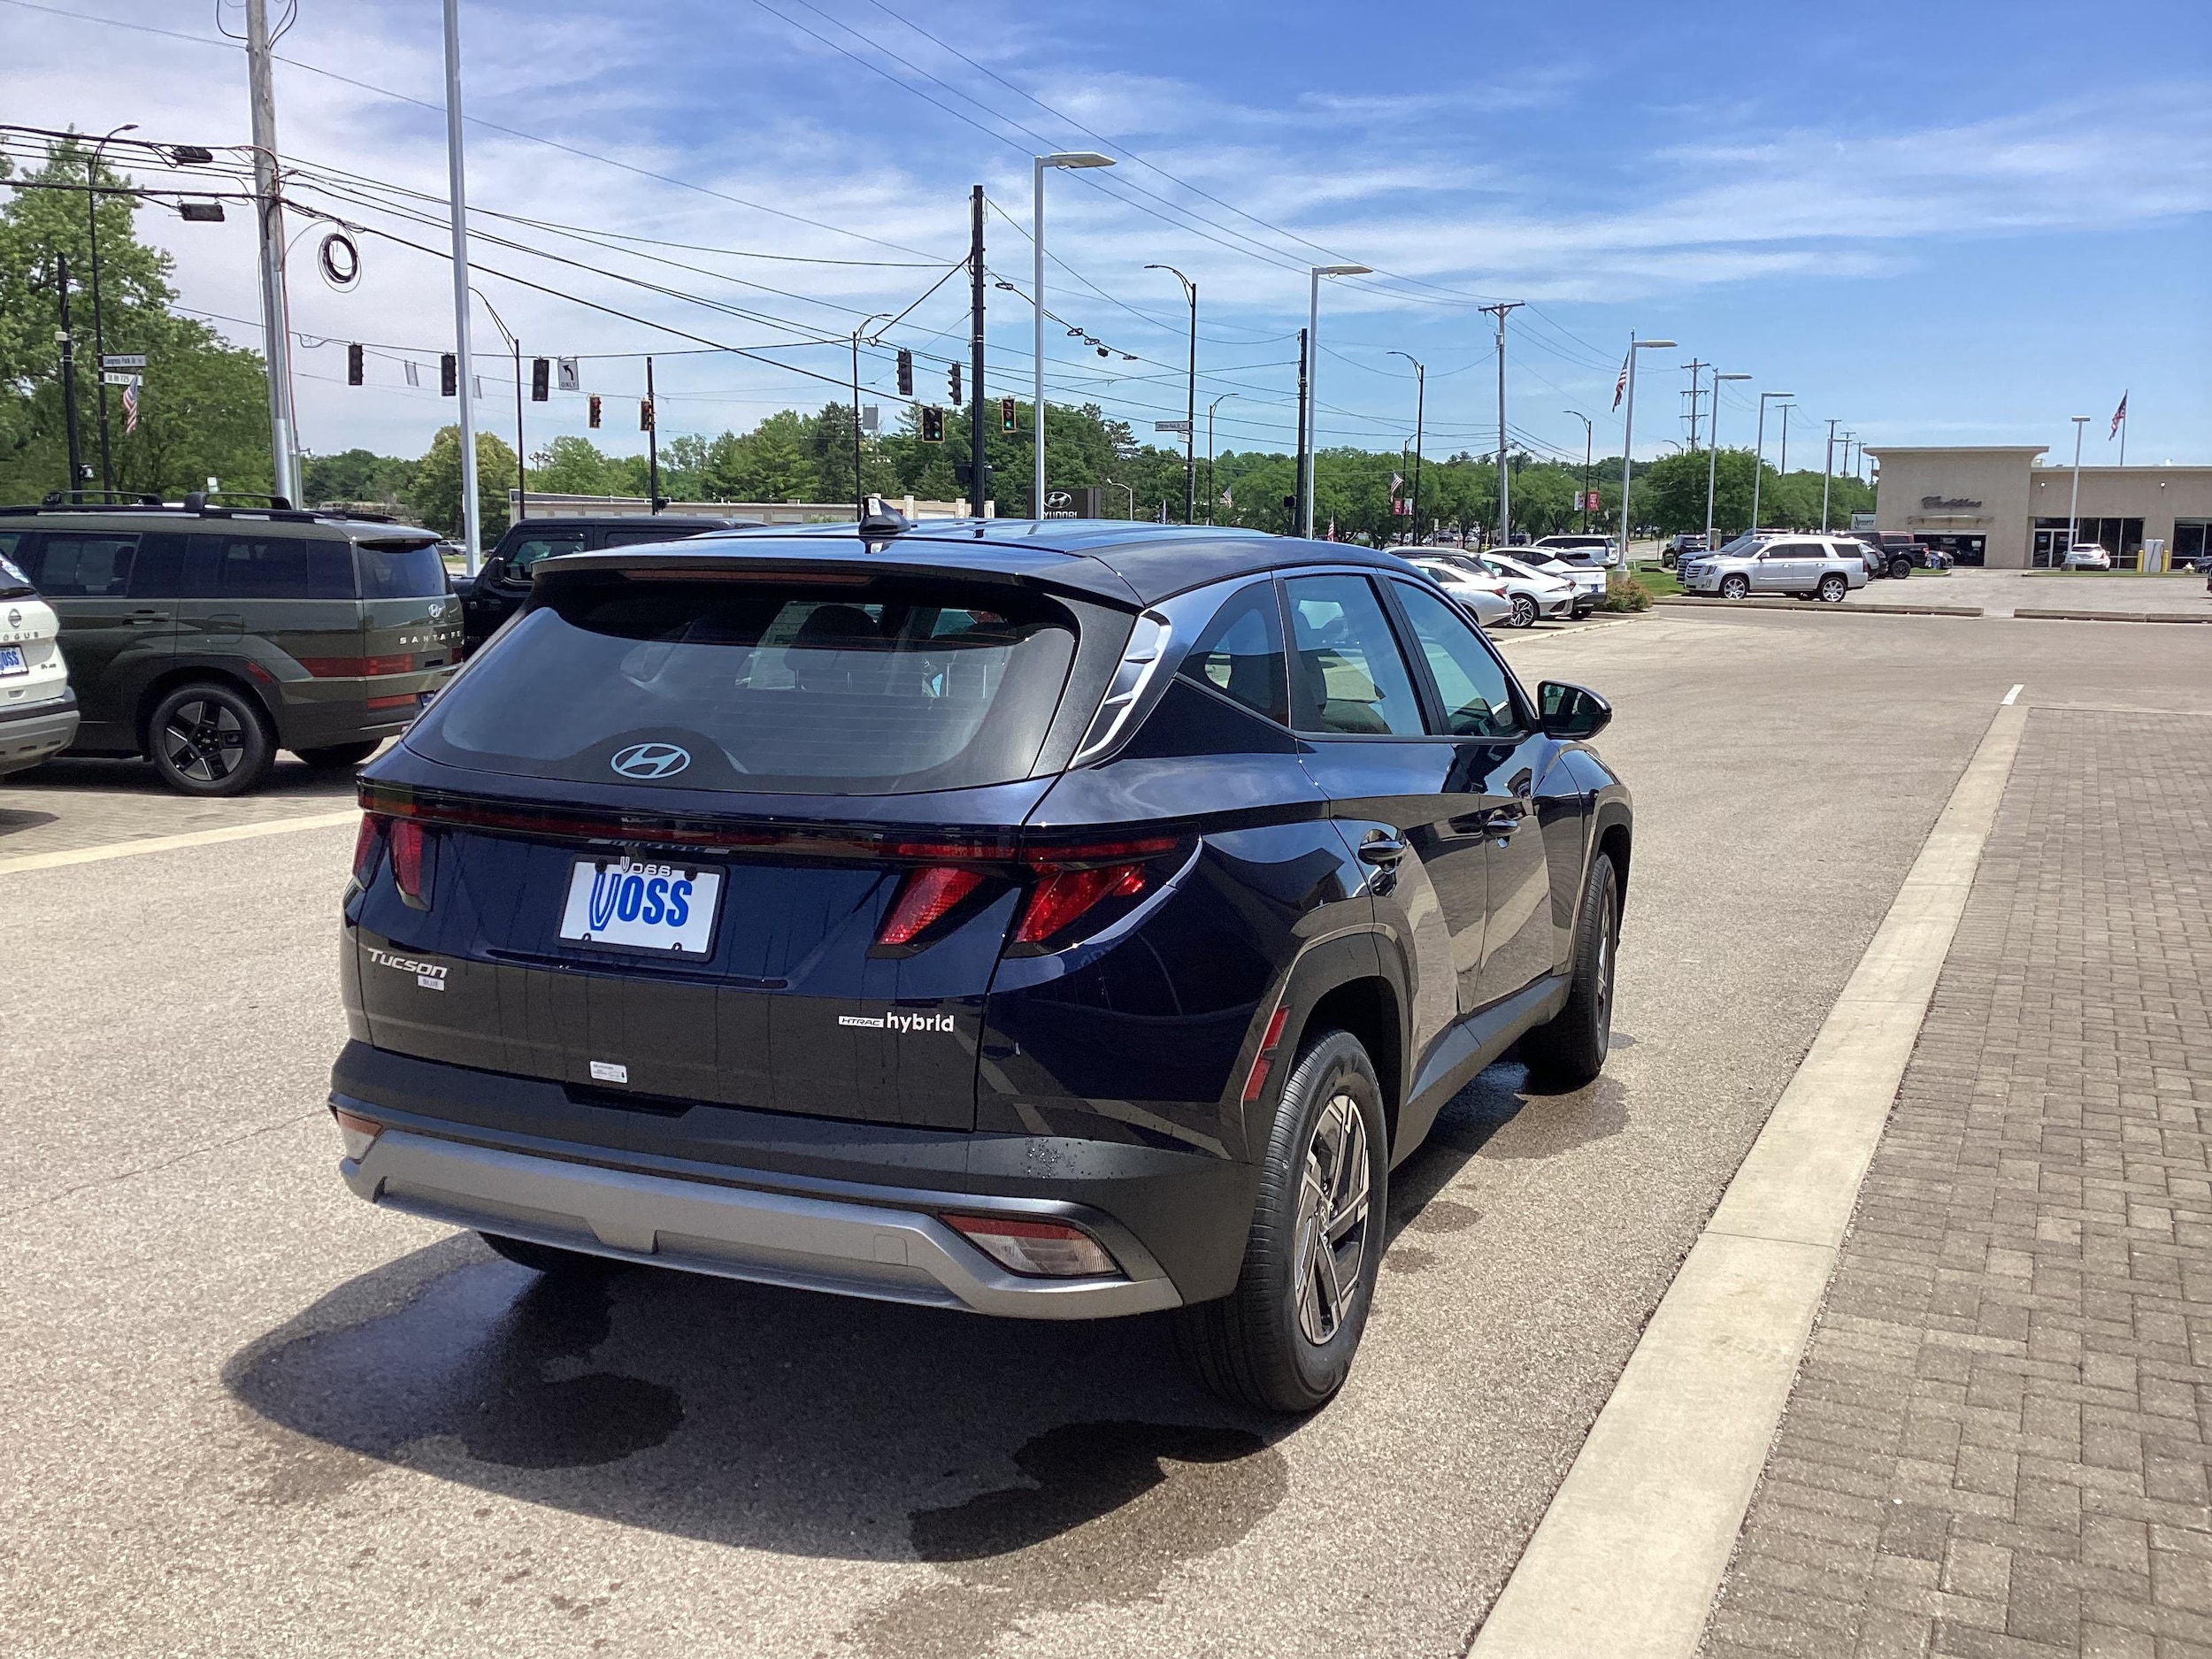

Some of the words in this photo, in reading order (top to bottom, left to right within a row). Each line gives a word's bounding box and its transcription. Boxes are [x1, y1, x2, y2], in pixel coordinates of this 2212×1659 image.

[1044, 511, 1078, 519] YUNDAI
[3, 631, 39, 641] OGUE
[399, 633, 446, 644] SANTA
[619, 856, 672, 877] VOSS
[588, 872, 693, 932] VOSS
[422, 978, 439, 988] BLUE
[841, 1018, 880, 1026] HTRAC
[887, 1011, 955, 1033] hybrid
